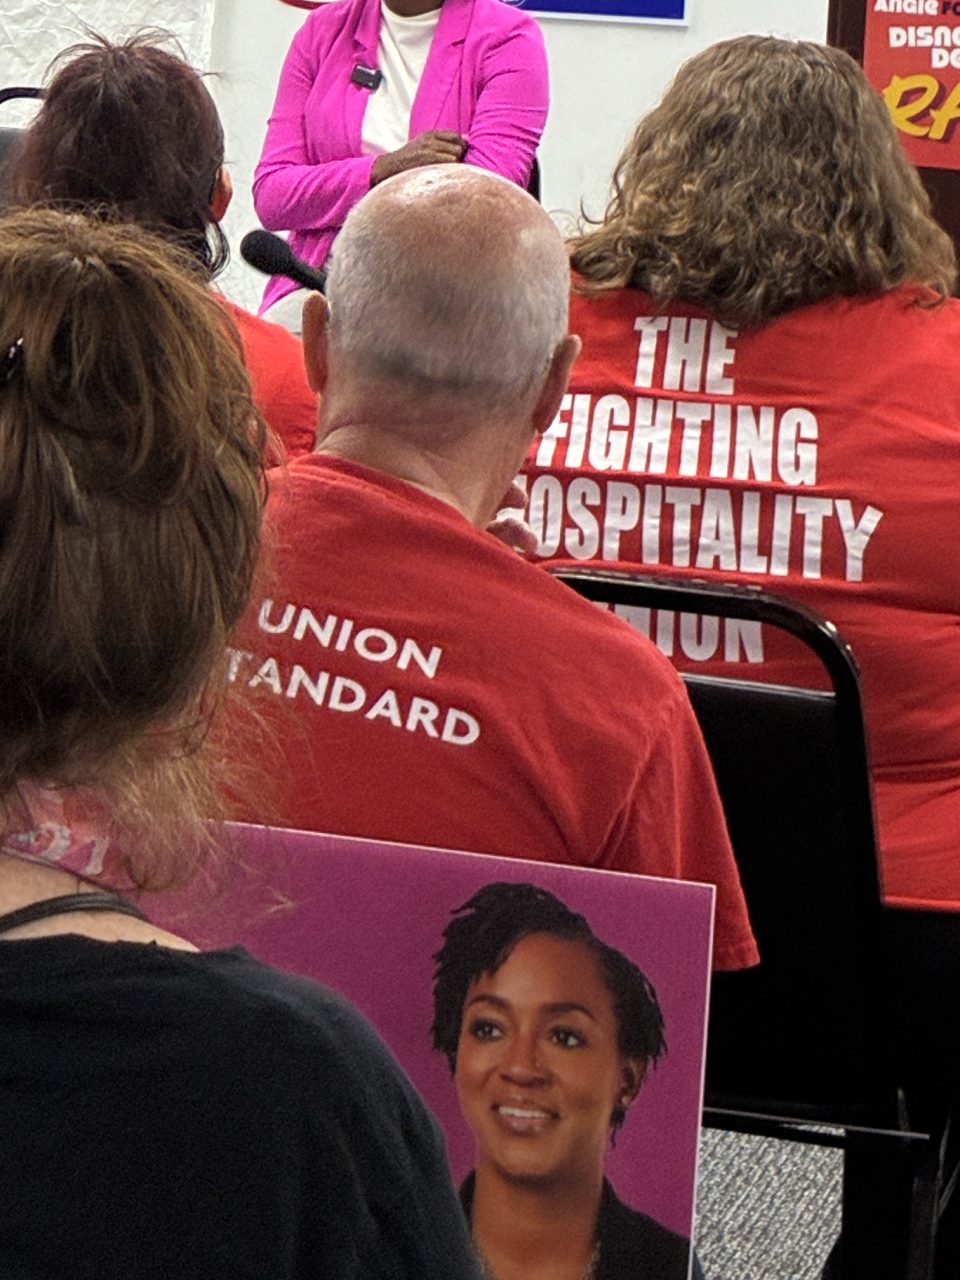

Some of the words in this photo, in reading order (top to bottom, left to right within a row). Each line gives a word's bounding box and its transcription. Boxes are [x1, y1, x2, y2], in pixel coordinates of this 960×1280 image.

[634, 316, 739, 395] THE
[536, 393, 819, 486] FIGHTING
[497, 473, 883, 582] OSPITALITY
[258, 598, 442, 679] UNION
[224, 646, 480, 746] TANDARD
